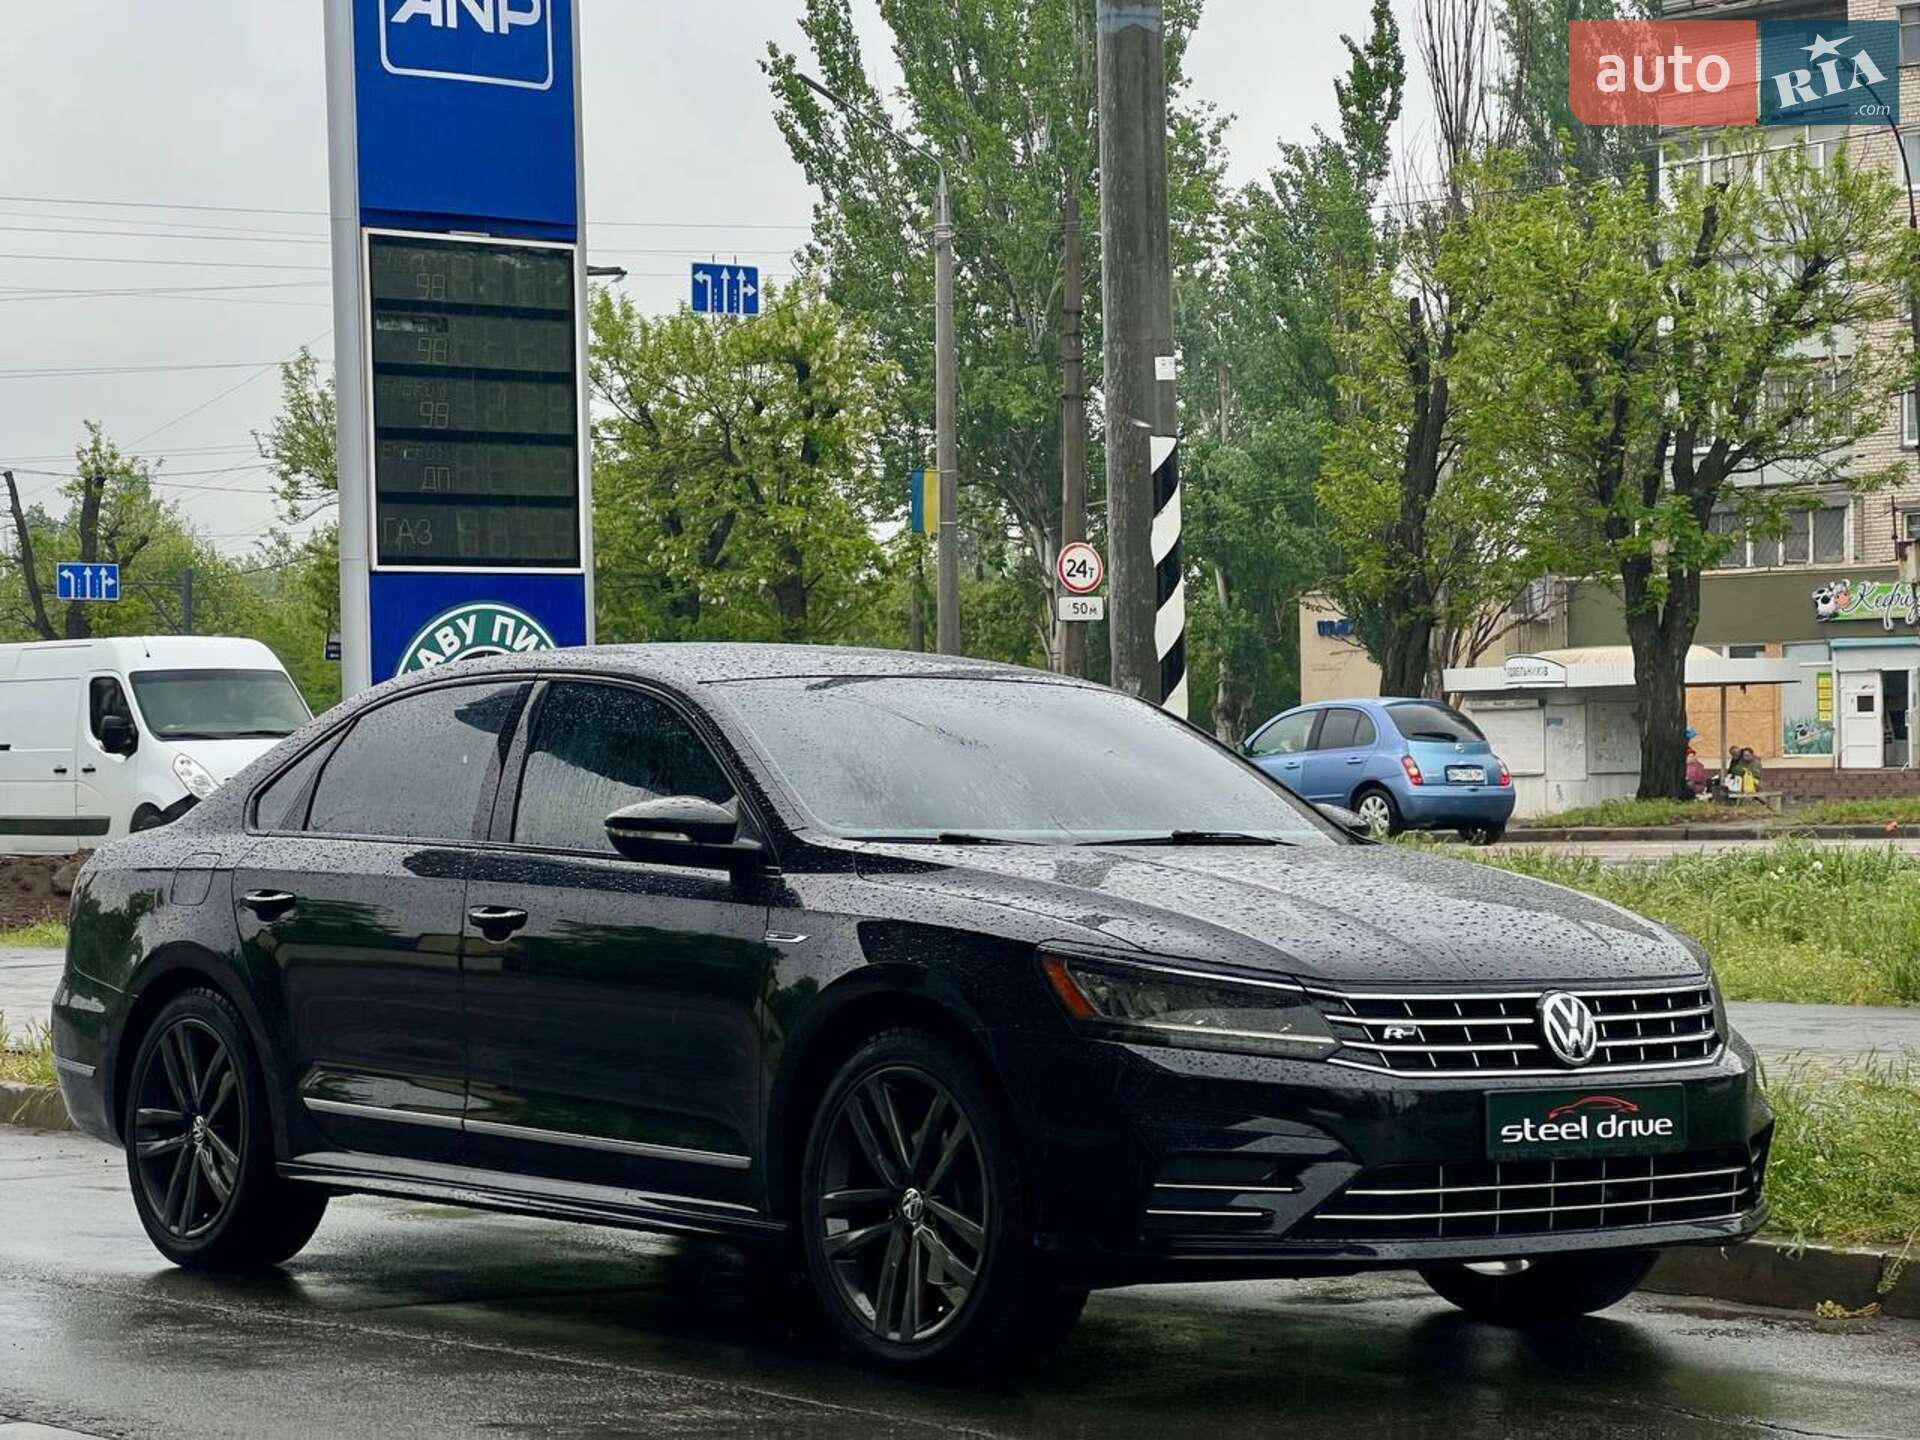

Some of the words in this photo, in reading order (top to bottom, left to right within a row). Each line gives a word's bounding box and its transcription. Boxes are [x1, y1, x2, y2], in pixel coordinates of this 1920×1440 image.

[383, 517, 433, 546] ГАЗ
[408, 614, 478, 671] АВУ
[492, 614, 548, 651] ПИ
[1501, 1115, 1588, 1143] steel
[1596, 1114, 1673, 1139] drive
